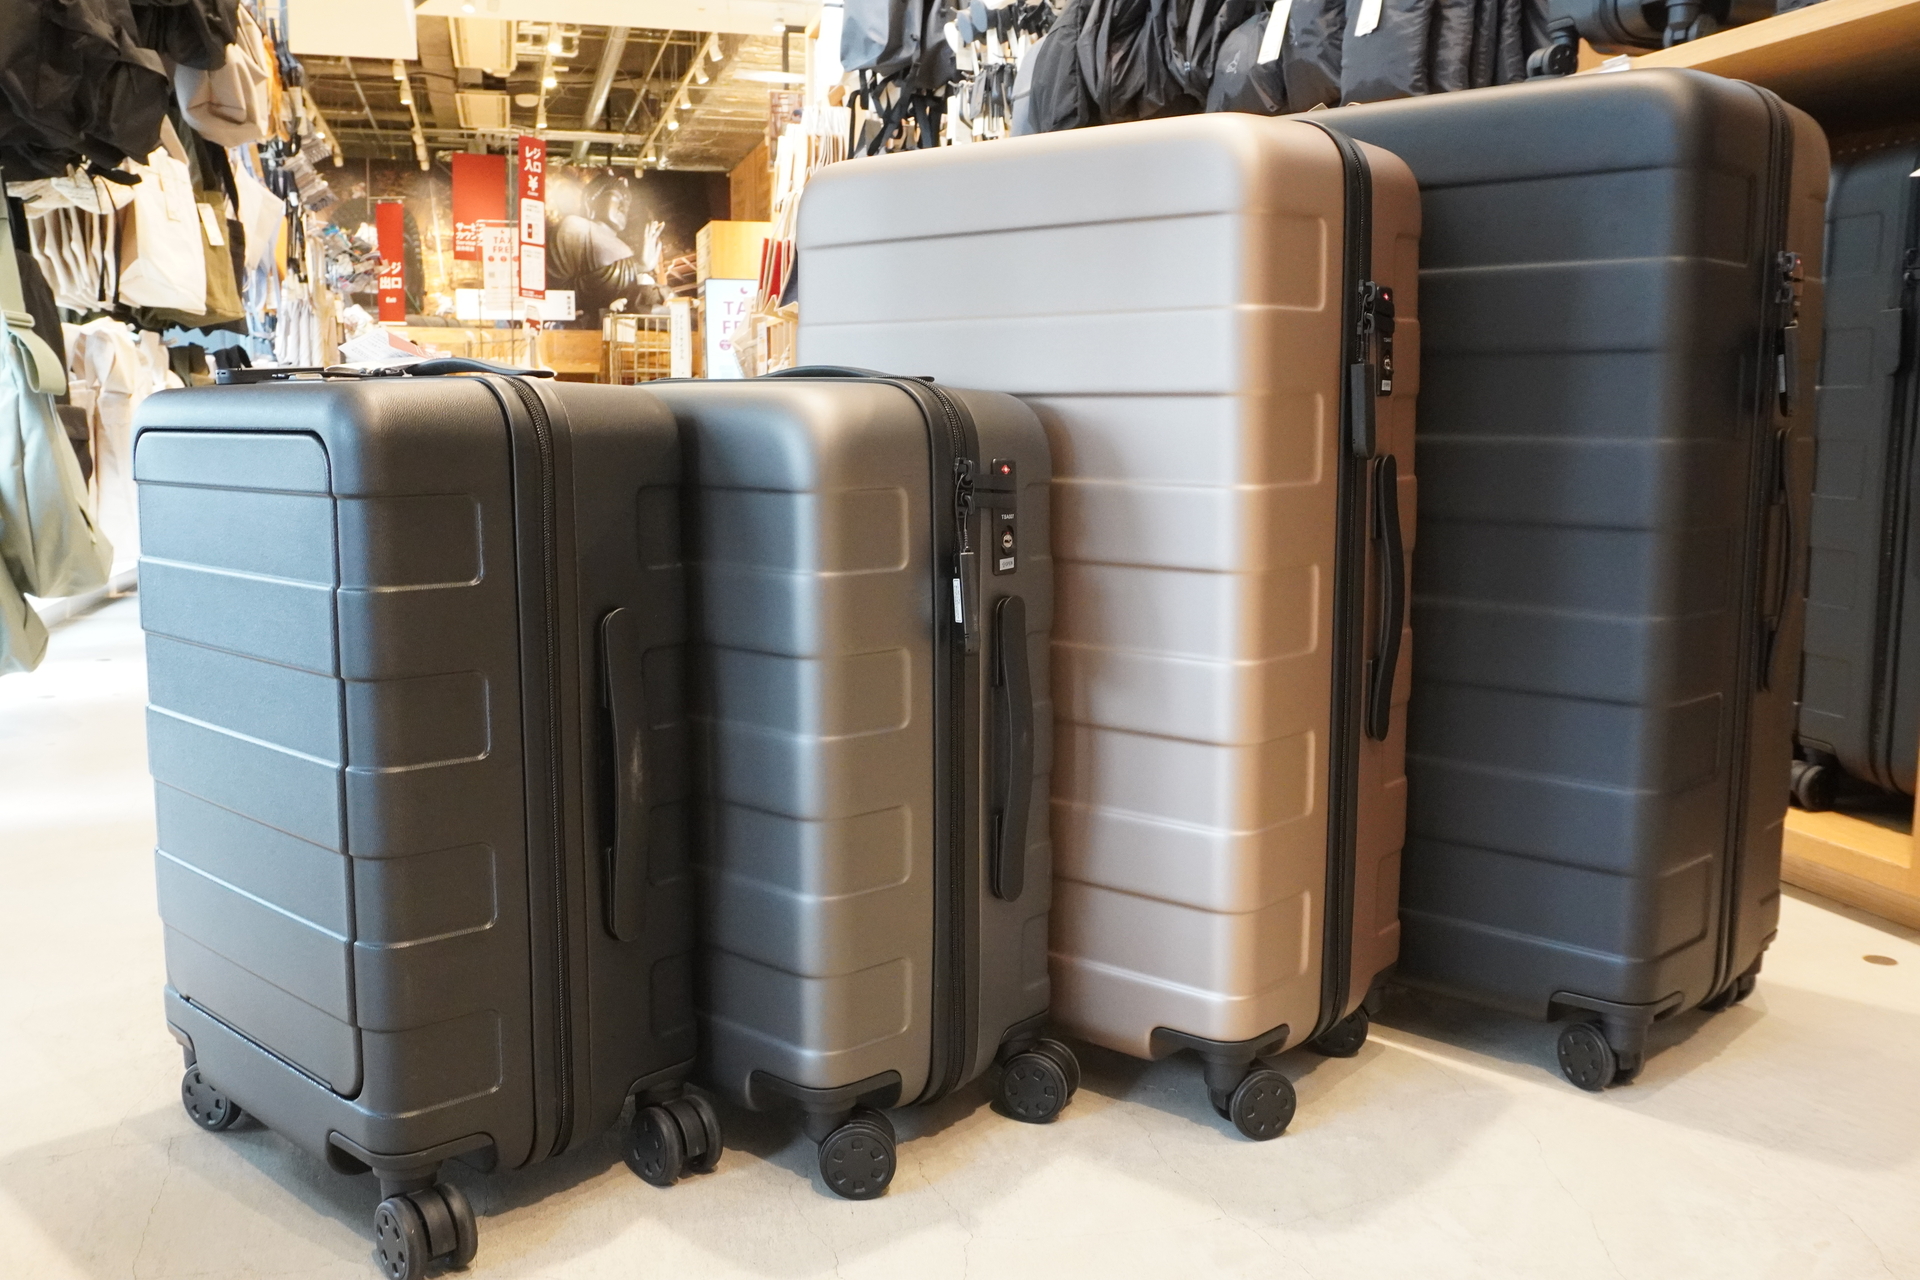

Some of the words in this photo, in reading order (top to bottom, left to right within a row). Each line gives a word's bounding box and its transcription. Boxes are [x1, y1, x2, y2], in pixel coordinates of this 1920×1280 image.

[525, 146, 542, 159] レジ
[524, 159, 542, 173] 入口
[493, 236, 513, 244] TAX
[493, 245, 514, 253] FREE
[379, 276, 402, 290] 出口
